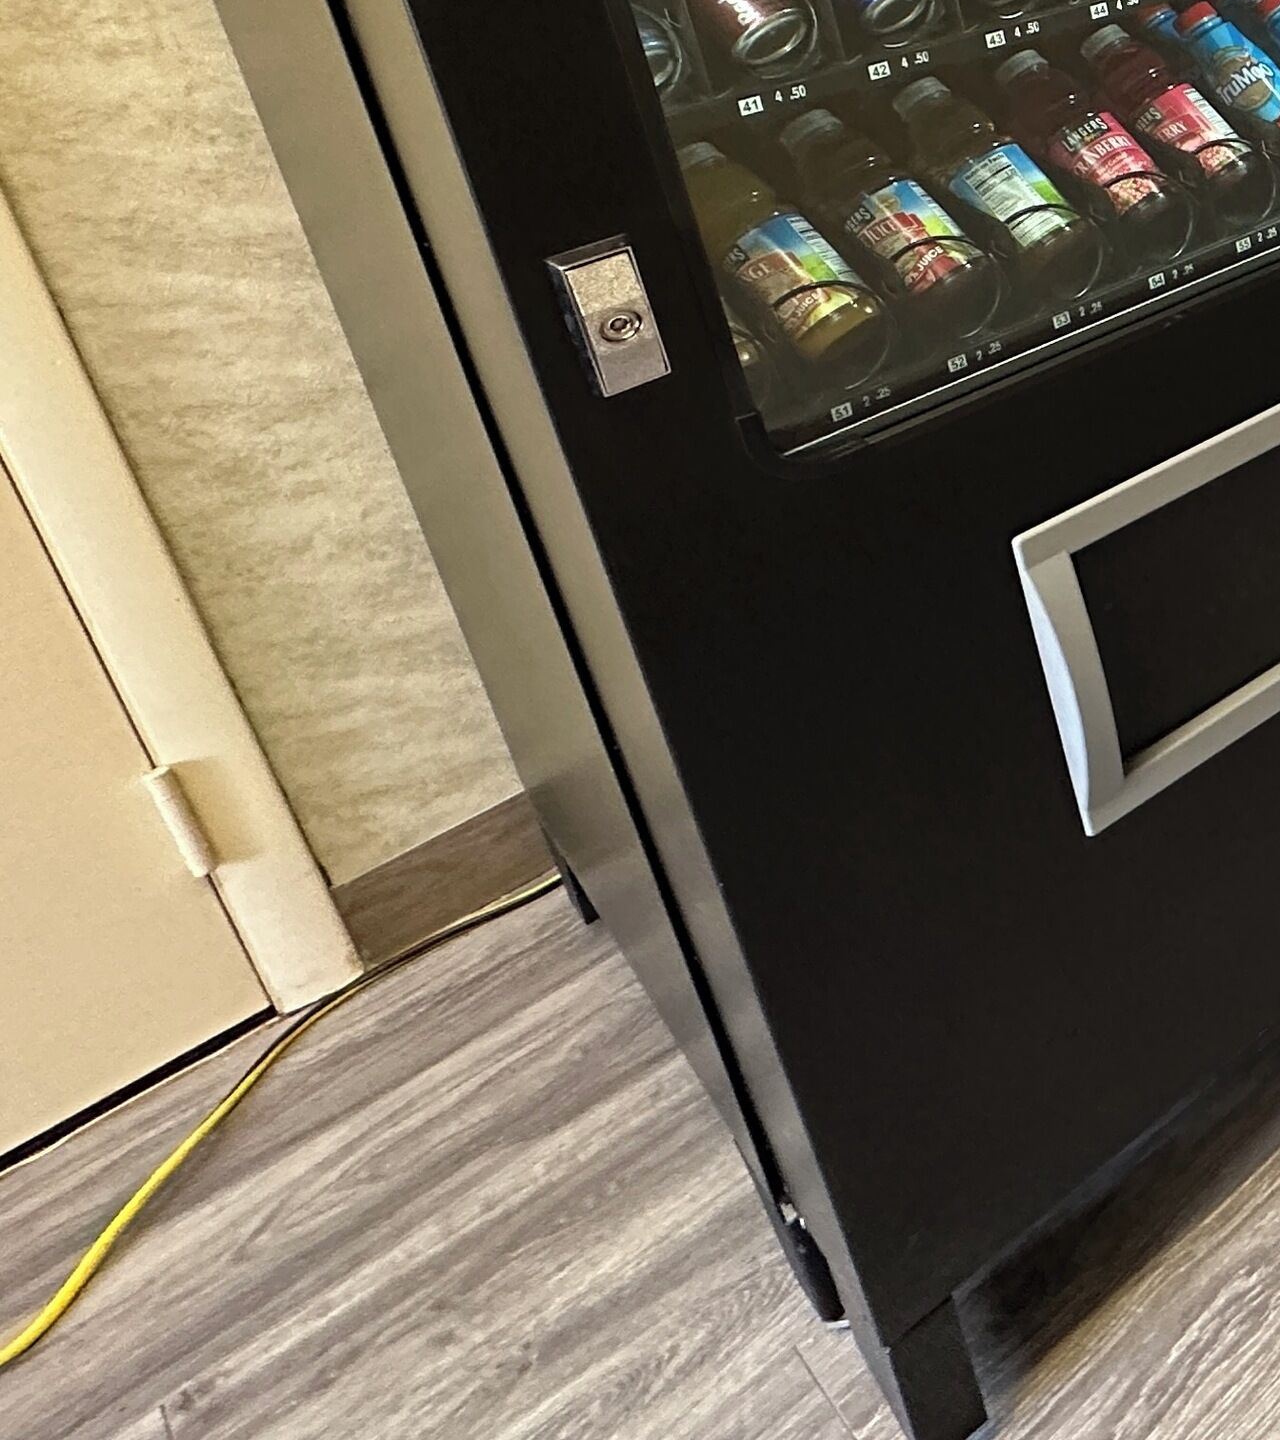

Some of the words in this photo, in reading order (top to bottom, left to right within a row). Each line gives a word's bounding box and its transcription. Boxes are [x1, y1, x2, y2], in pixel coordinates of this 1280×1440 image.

[1093, 4, 1107, 17] 44
[989, 33, 1004, 46] 43
[1014, 26, 1022, 38] 4
[1026, 20, 1040, 35] .50
[872, 64, 888, 77] 42
[901, 57, 909, 68] 4
[914, 50, 930, 65] .50
[1216, 62, 1275, 107] TruMoo
[743, 98, 760, 113] 41
[775, 90, 783, 102] 4
[790, 84, 807, 100] .50
[1062, 117, 1108, 152] LANGERS
[1238, 240, 1251, 251] 55
[1257, 231, 1264, 243] 2
[918, 245, 945, 272] JUICE
[1151, 276, 1164, 287] 54
[1055, 314, 1070, 326] 53
[951, 357, 966, 370] 52
[976, 349, 983, 361] 2
